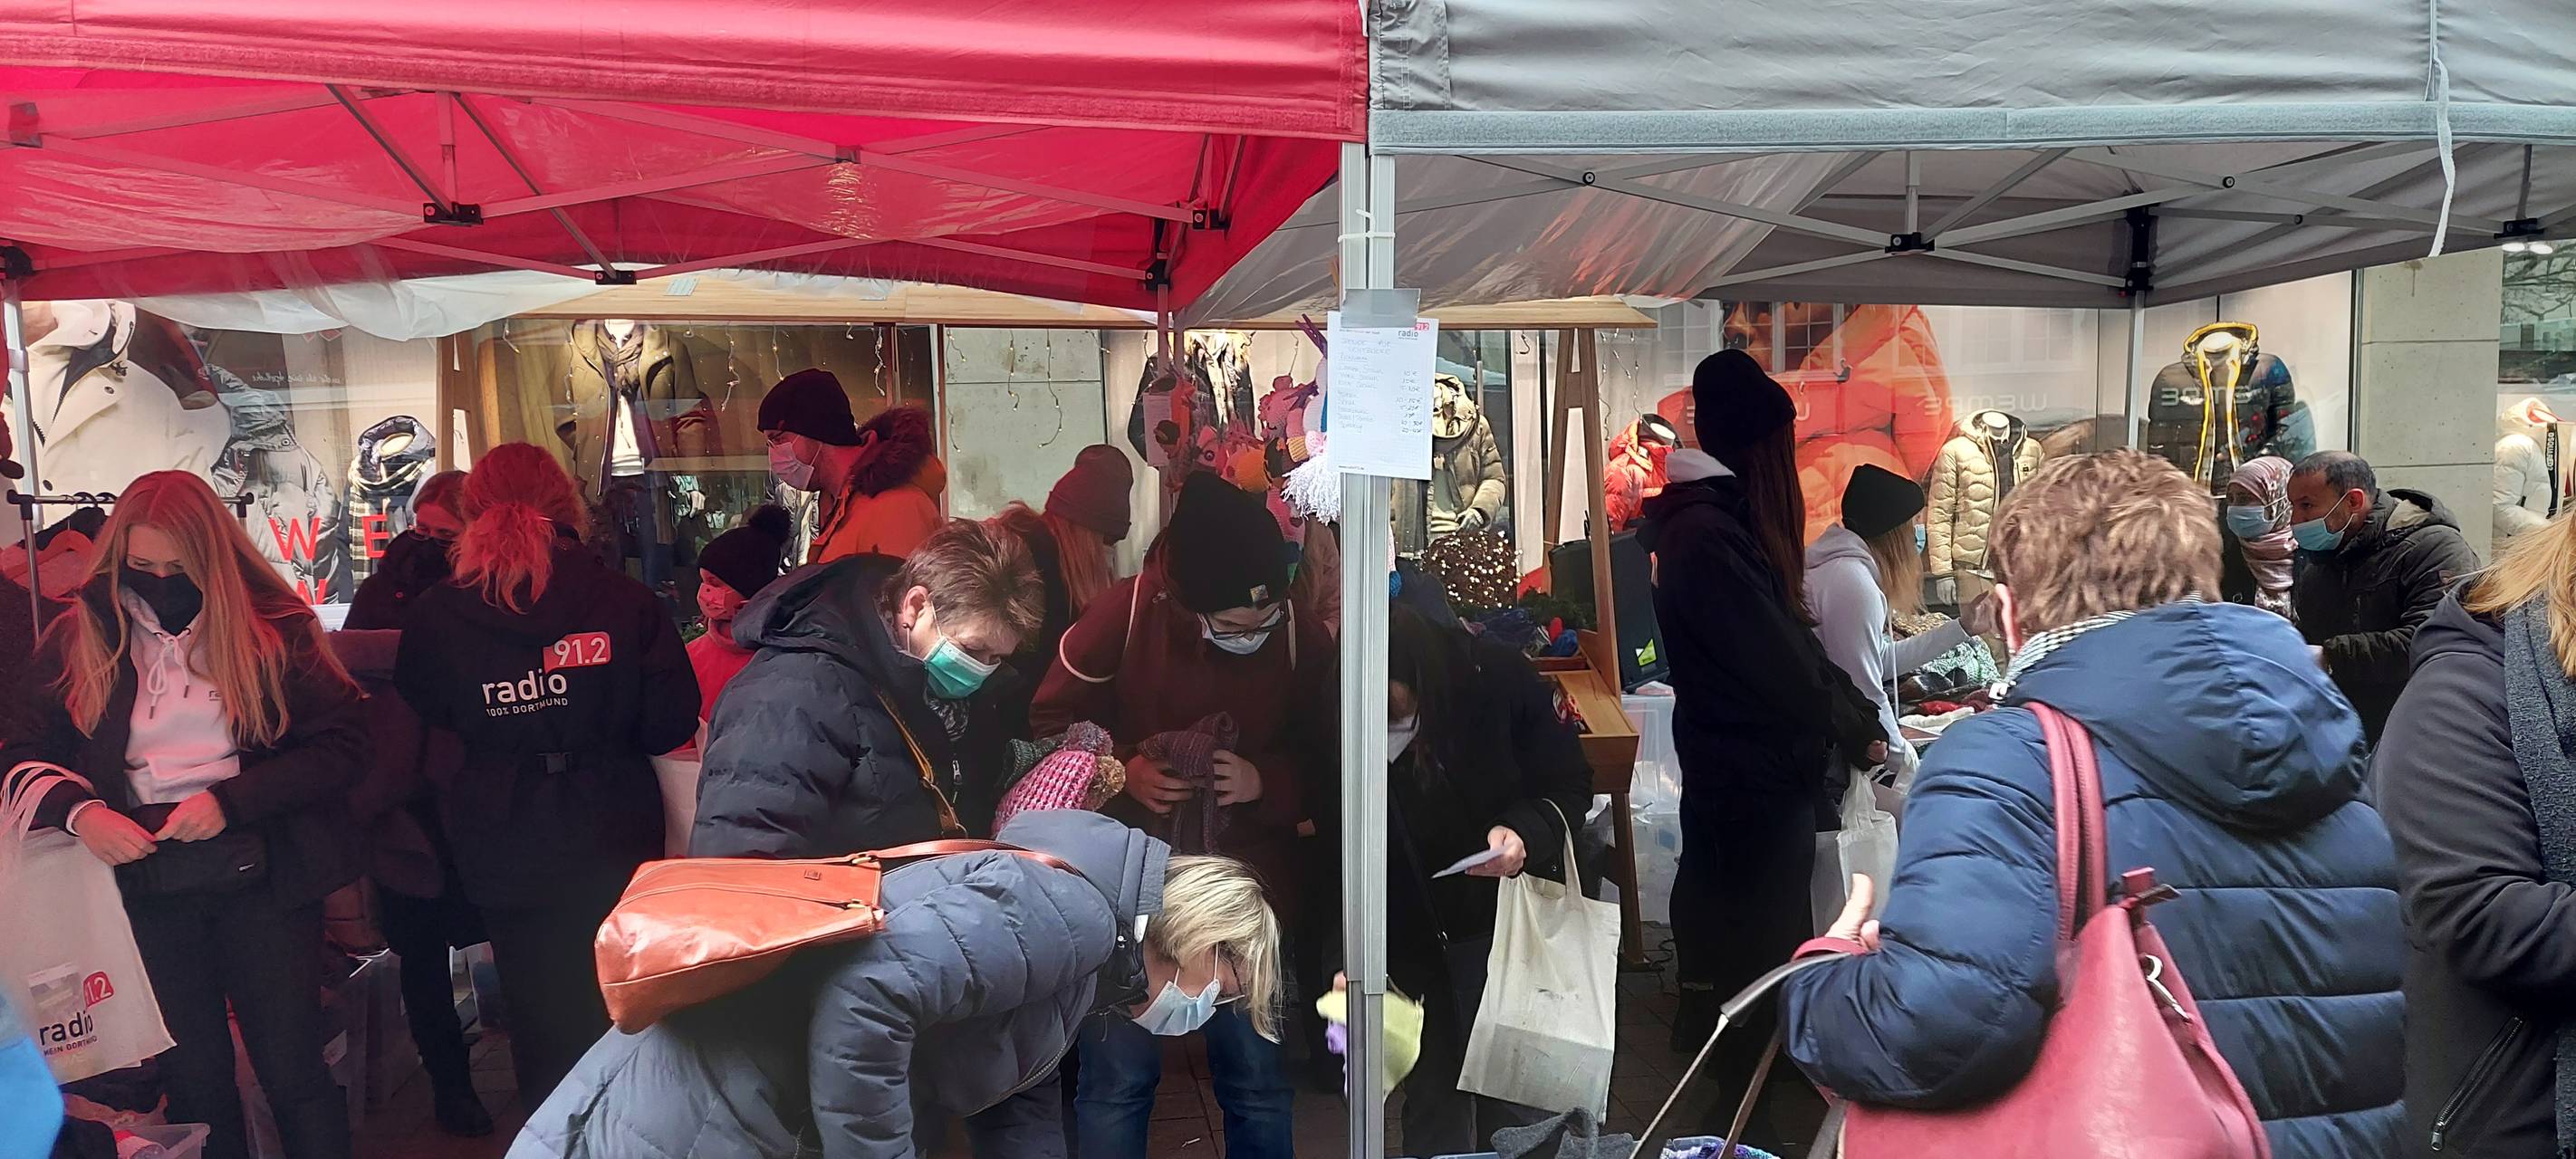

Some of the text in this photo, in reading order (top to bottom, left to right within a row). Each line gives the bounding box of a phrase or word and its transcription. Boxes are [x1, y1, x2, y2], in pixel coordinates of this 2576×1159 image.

[1398, 330, 1419, 339] radio
[553, 637, 607, 666] 91.2
[482, 668, 568, 704] radio
[486, 697, 569, 718] 100% DORTMUND
[86, 976, 112, 1004] 1.2
[39, 1009, 93, 1046] radio
